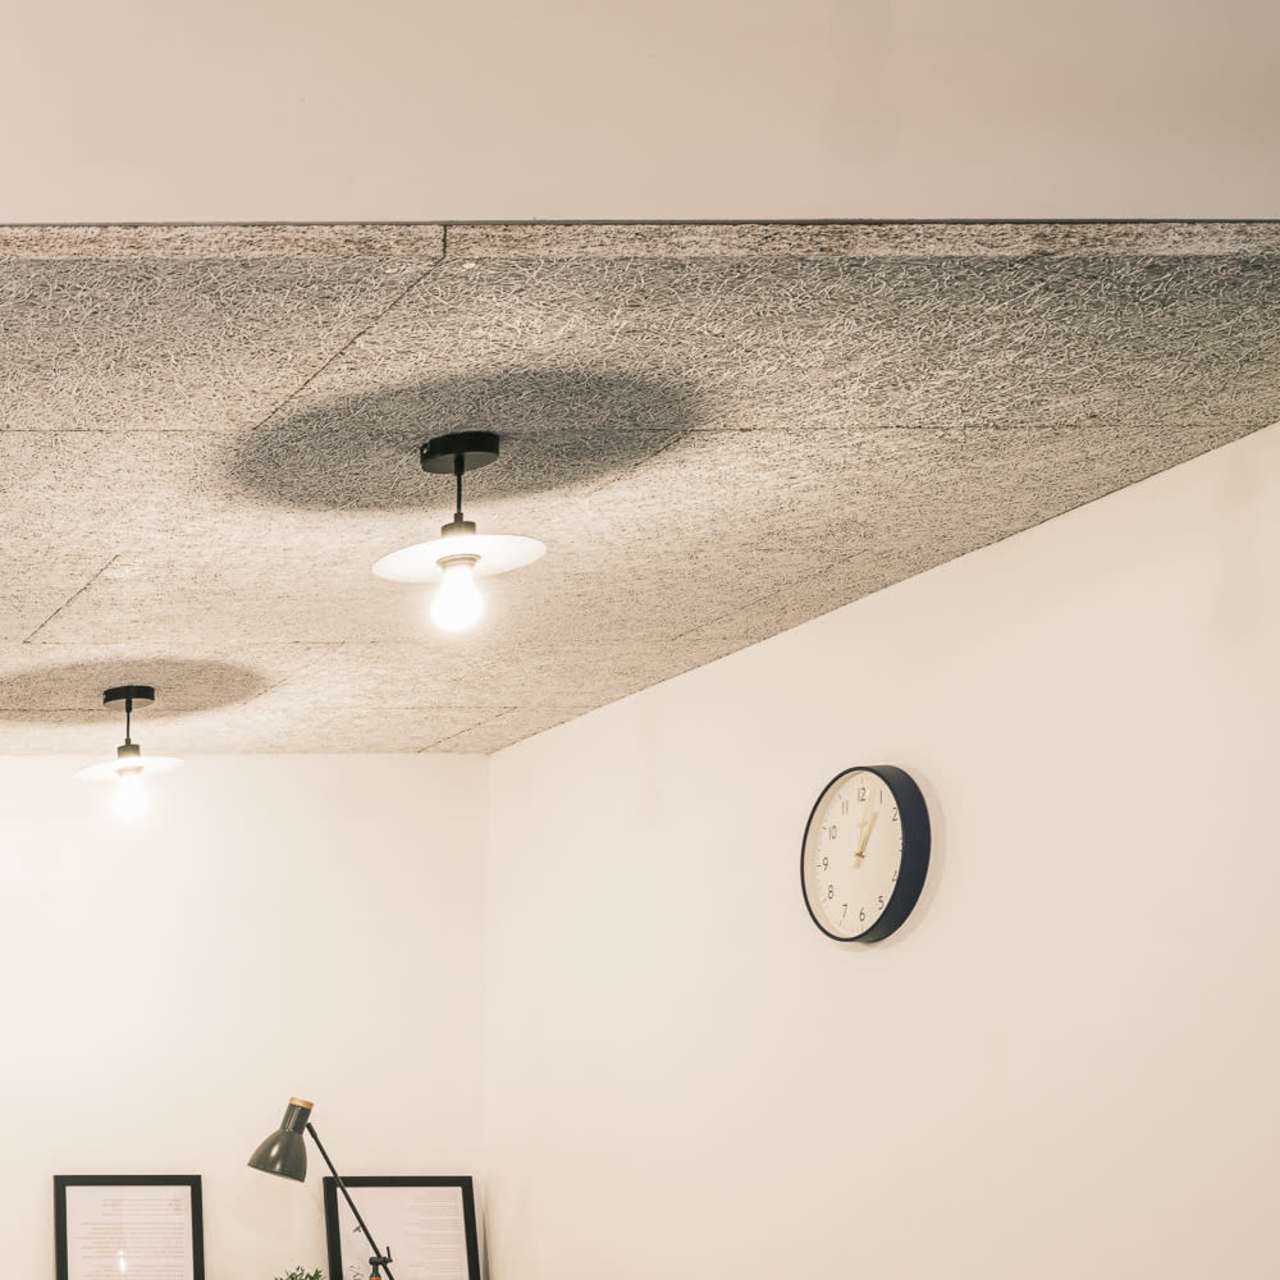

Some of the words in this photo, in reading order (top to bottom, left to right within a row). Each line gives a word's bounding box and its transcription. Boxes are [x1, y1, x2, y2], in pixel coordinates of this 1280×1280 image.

[857, 787, 866, 801] 12
[841, 800, 849, 816] 11
[892, 807, 898, 822] 2
[828, 825, 837, 840] 10
[822, 856, 829, 871] 9
[827, 884, 834, 899] 8
[877, 895, 885, 911] 5
[841, 903, 849, 919] 7
[859, 907, 866, 922] 6
